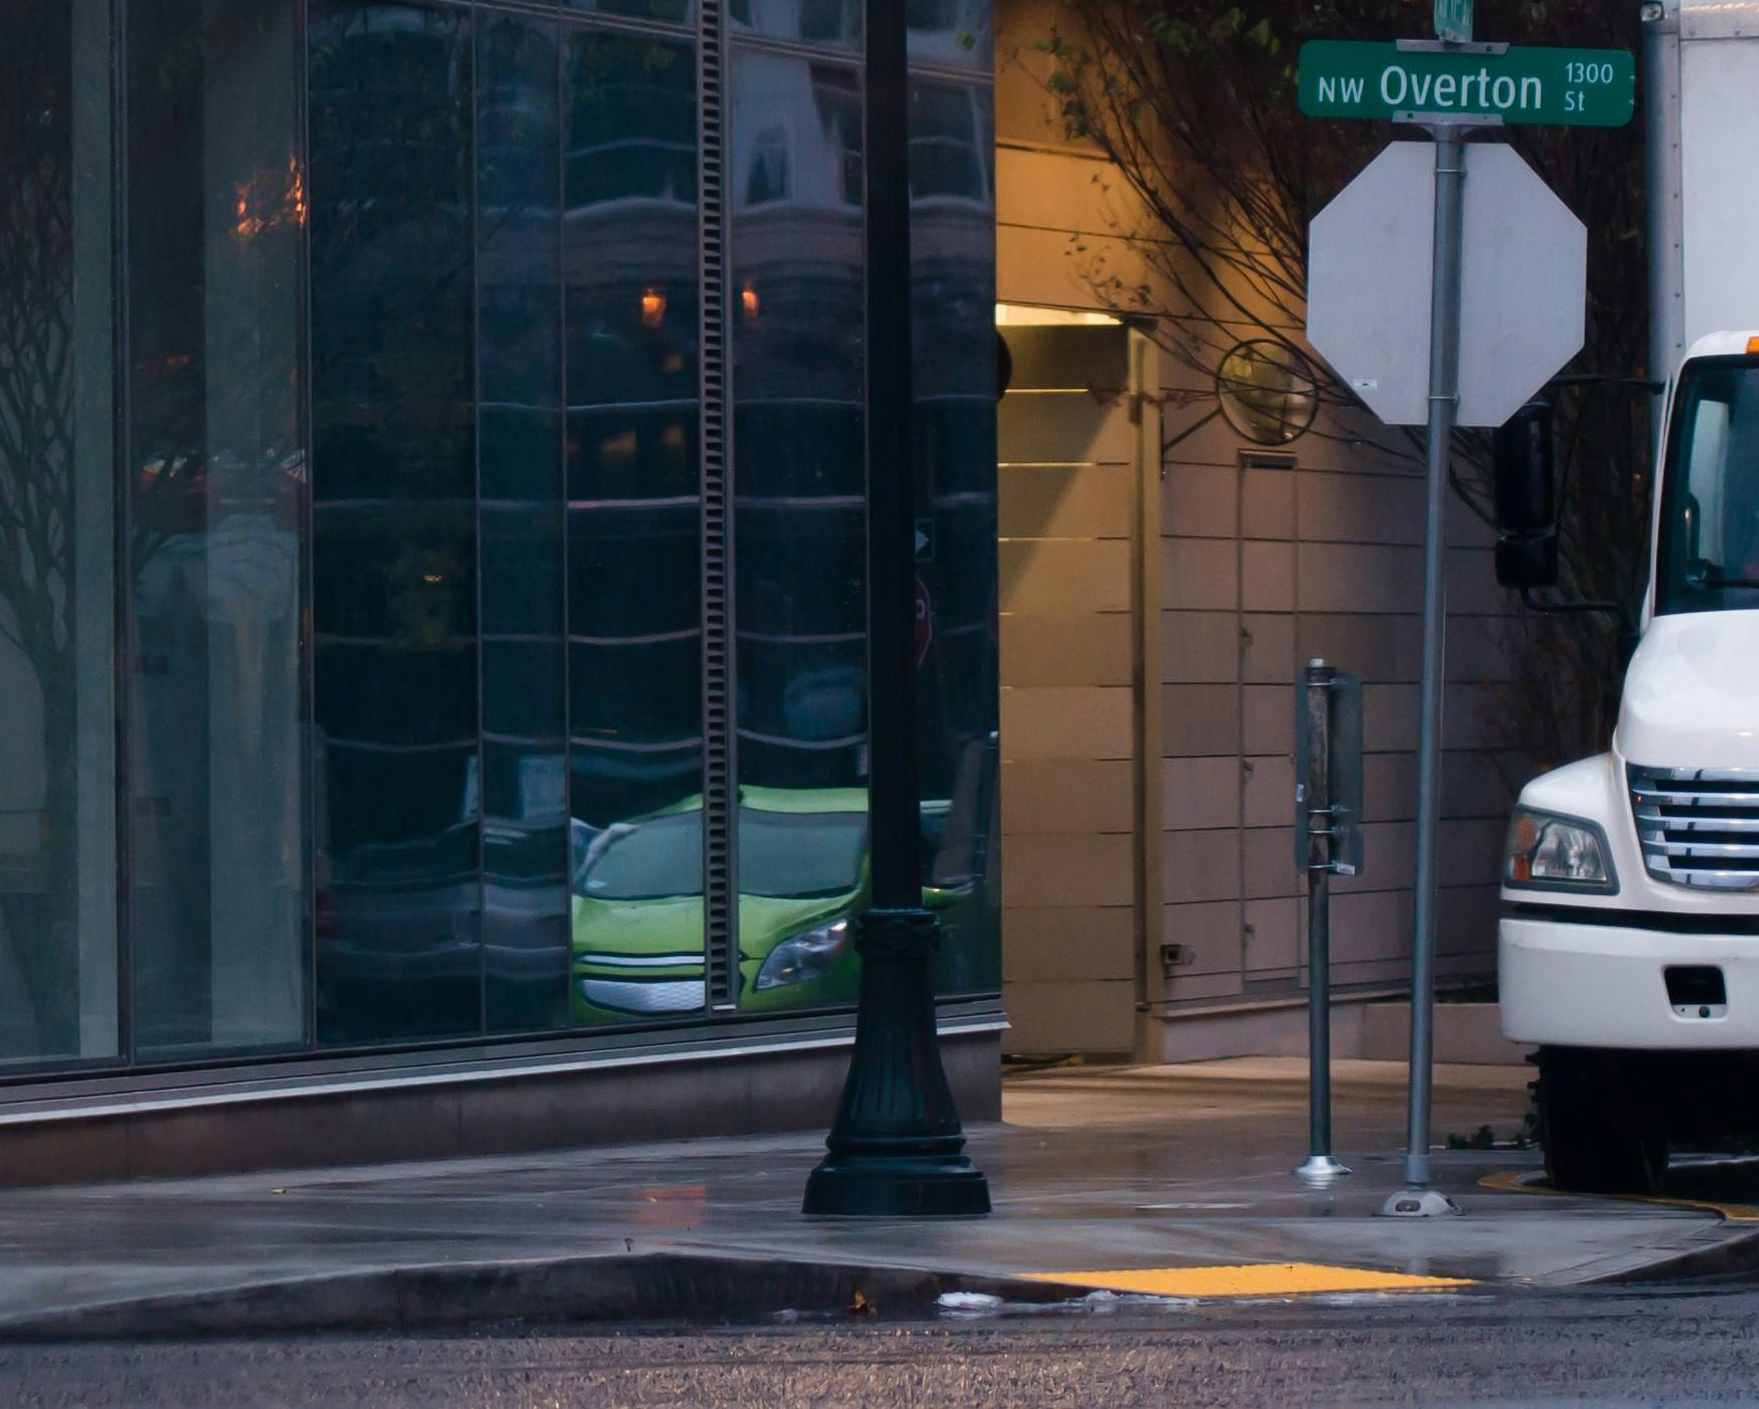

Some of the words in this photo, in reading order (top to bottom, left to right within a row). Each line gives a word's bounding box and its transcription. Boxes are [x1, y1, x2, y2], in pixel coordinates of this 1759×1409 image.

[1565, 62, 1614, 84] 1300
[1318, 76, 1364, 103] NW
[1380, 65, 1542, 109] Overton
[1564, 91, 1585, 111] St
